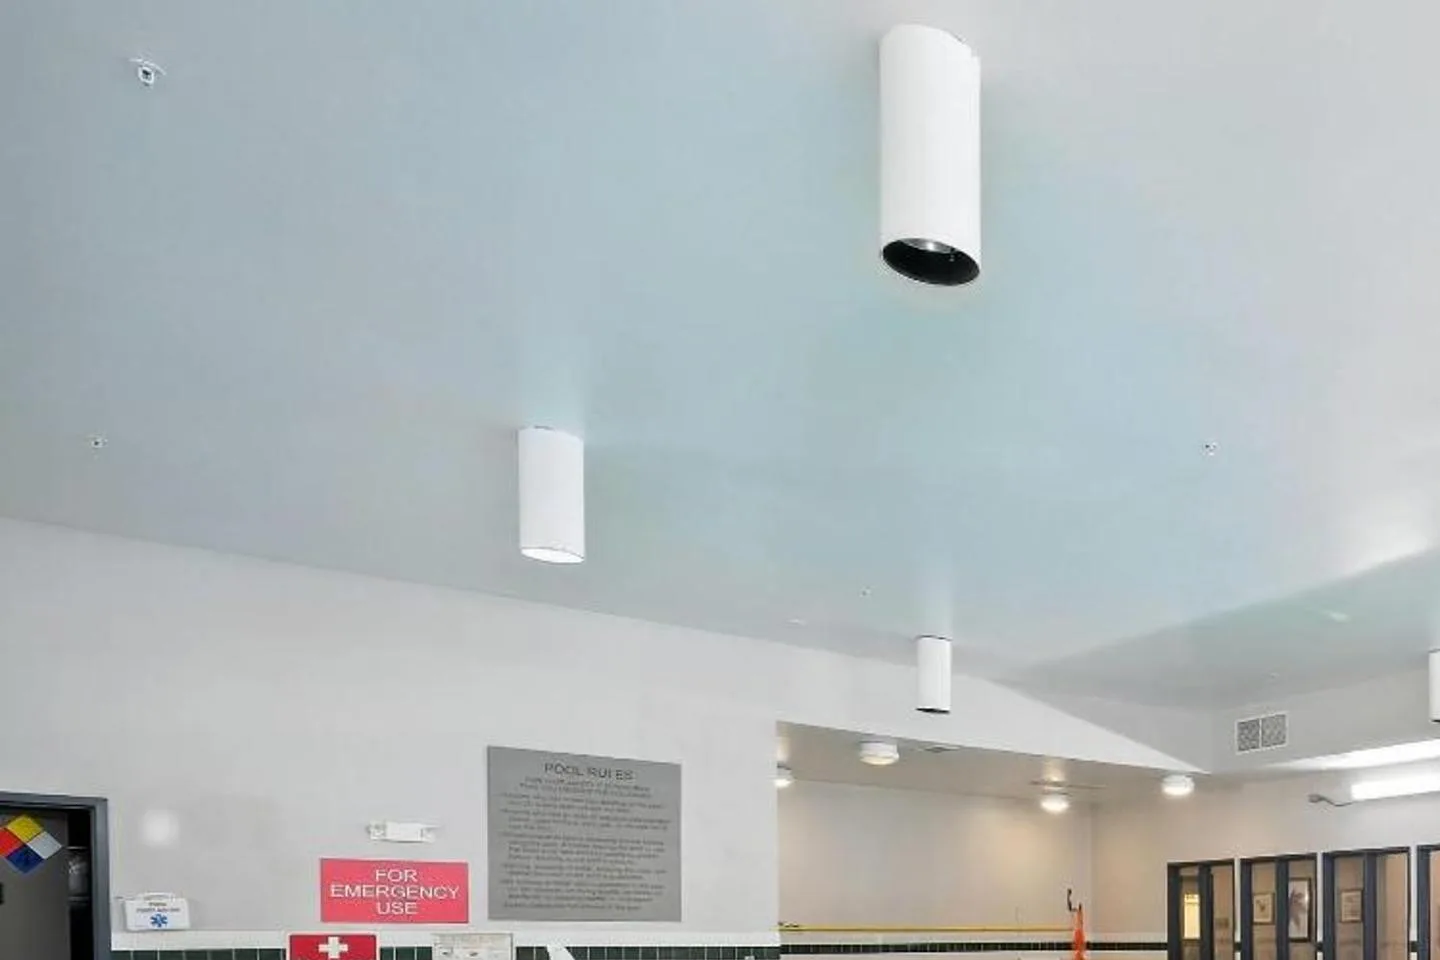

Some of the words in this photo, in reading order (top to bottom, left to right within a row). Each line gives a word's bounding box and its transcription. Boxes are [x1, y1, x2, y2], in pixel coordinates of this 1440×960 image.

[544, 761, 584, 777] POOL
[587, 766, 635, 781] RULES
[375, 869, 418, 883] FOR
[330, 884, 460, 900] EMERGENCY
[376, 901, 419, 916] USE
